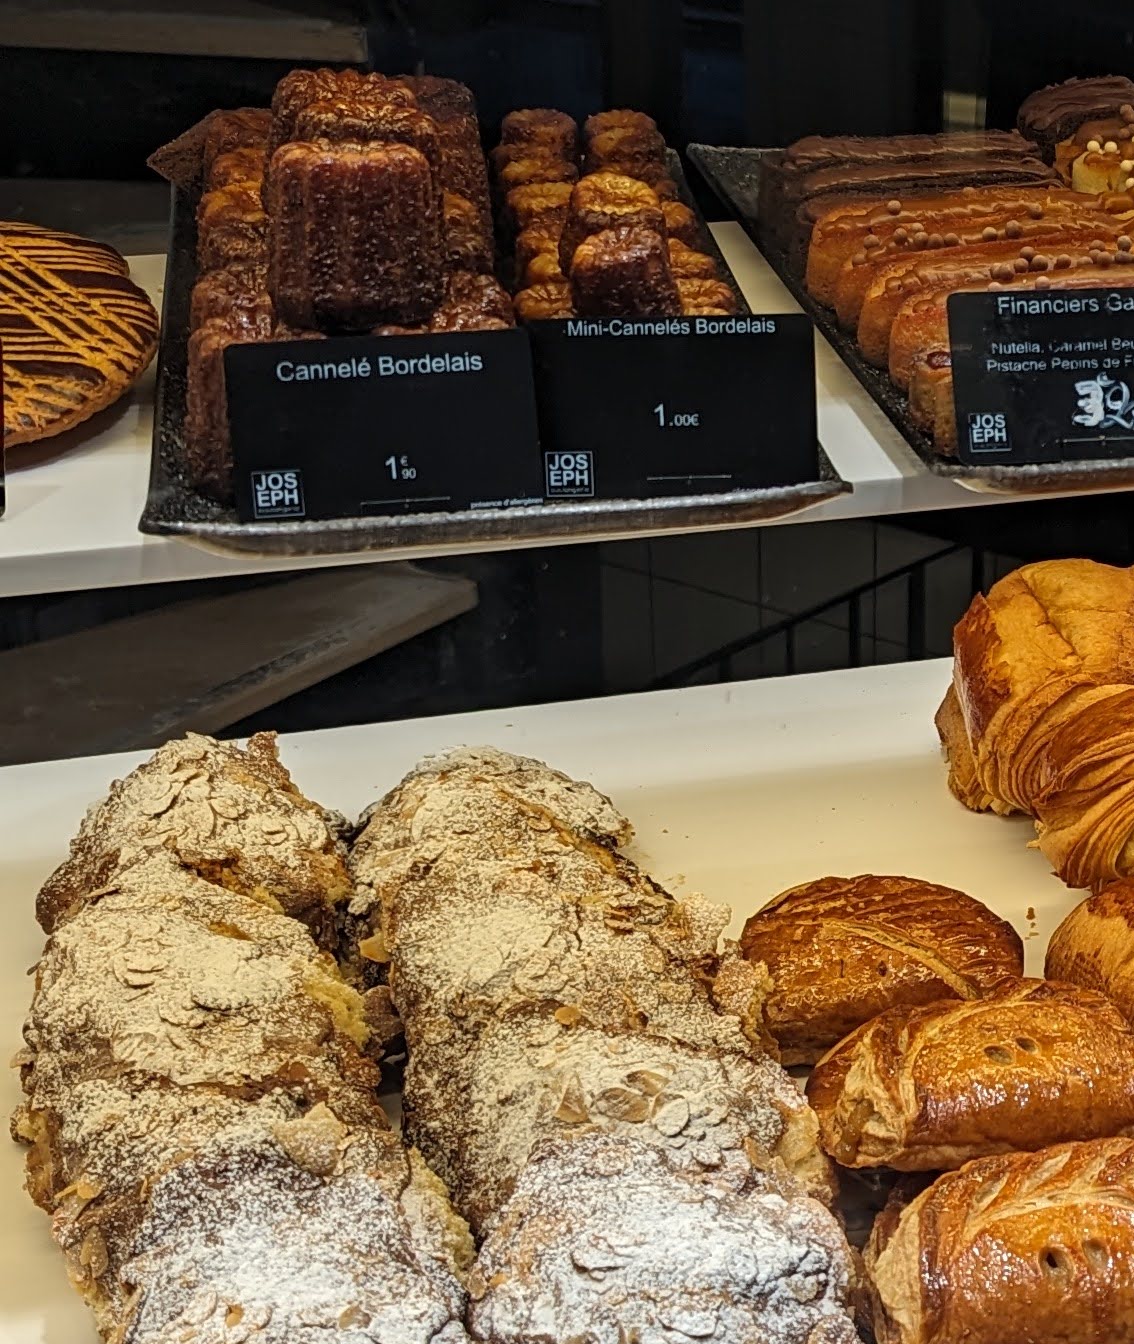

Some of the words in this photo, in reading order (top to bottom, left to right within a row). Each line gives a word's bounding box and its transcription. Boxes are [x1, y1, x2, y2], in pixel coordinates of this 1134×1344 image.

[997, 296, 1100, 316] Financiers
[567, 318, 690, 337] Mini-Cannelés
[695, 317, 776, 335] Bordelais
[1049, 339, 1108, 353] Caramel
[276, 357, 372, 383] Cannelé
[378, 351, 483, 377] Bordelais
[986, 358, 1047, 373] Pistache
[1102, 356, 1120, 369] de
[653, 403, 700, 428] 1.00€
[971, 414, 1006, 429] JOS
[972, 428, 1007, 444] EPH
[549, 454, 589, 471] JOS
[255, 473, 298, 492] JOS
[549, 470, 589, 487] EPH
[256, 489, 299, 507] EPH
